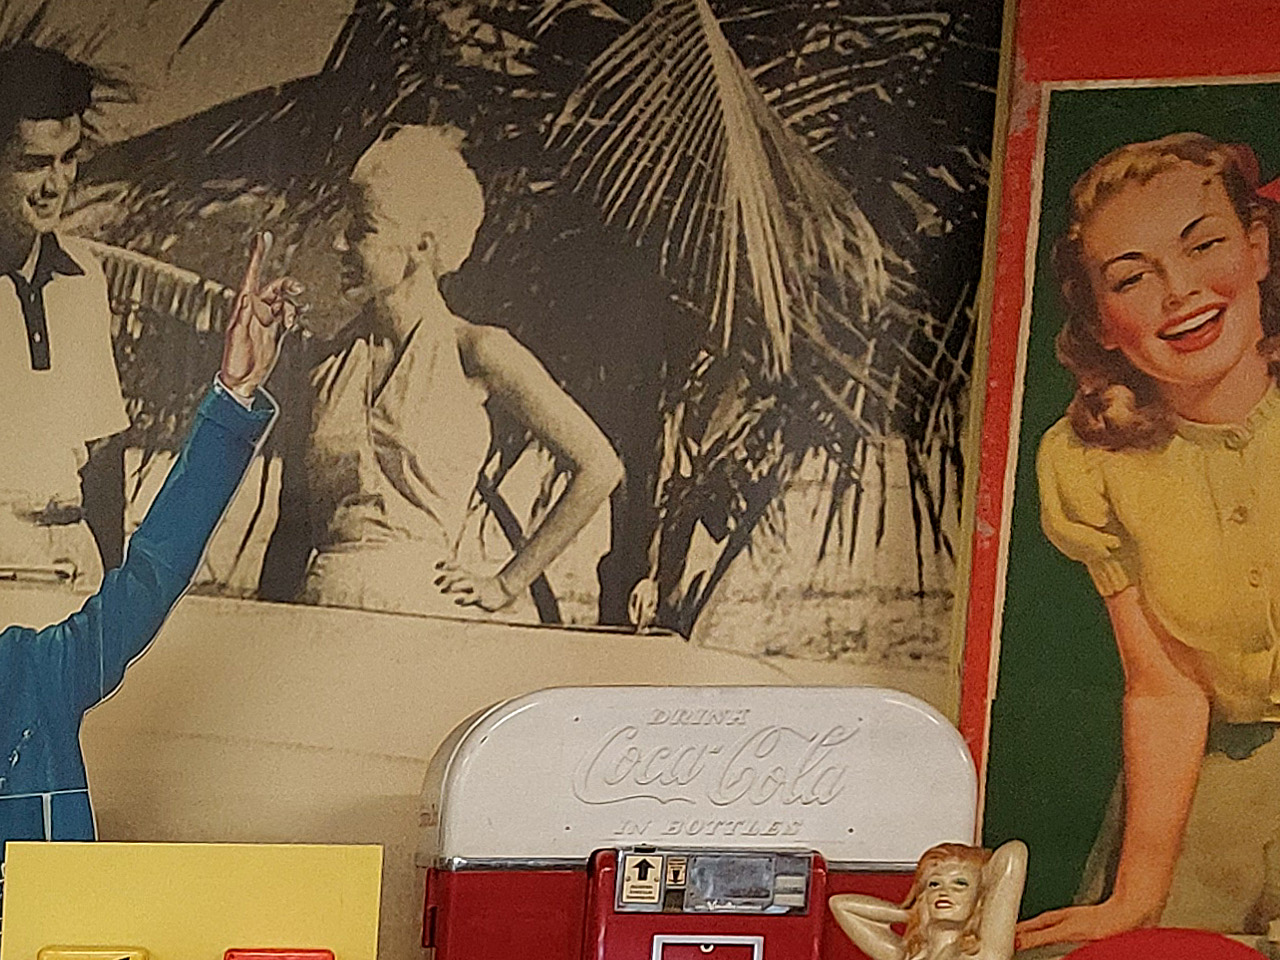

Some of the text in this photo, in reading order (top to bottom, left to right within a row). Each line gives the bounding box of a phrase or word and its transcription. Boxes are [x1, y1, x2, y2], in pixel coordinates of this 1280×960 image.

[646, 708, 751, 726] DRINK
[572, 725, 861, 807] Coca-Cola
[613, 820, 803, 837] IN BOTTLES
